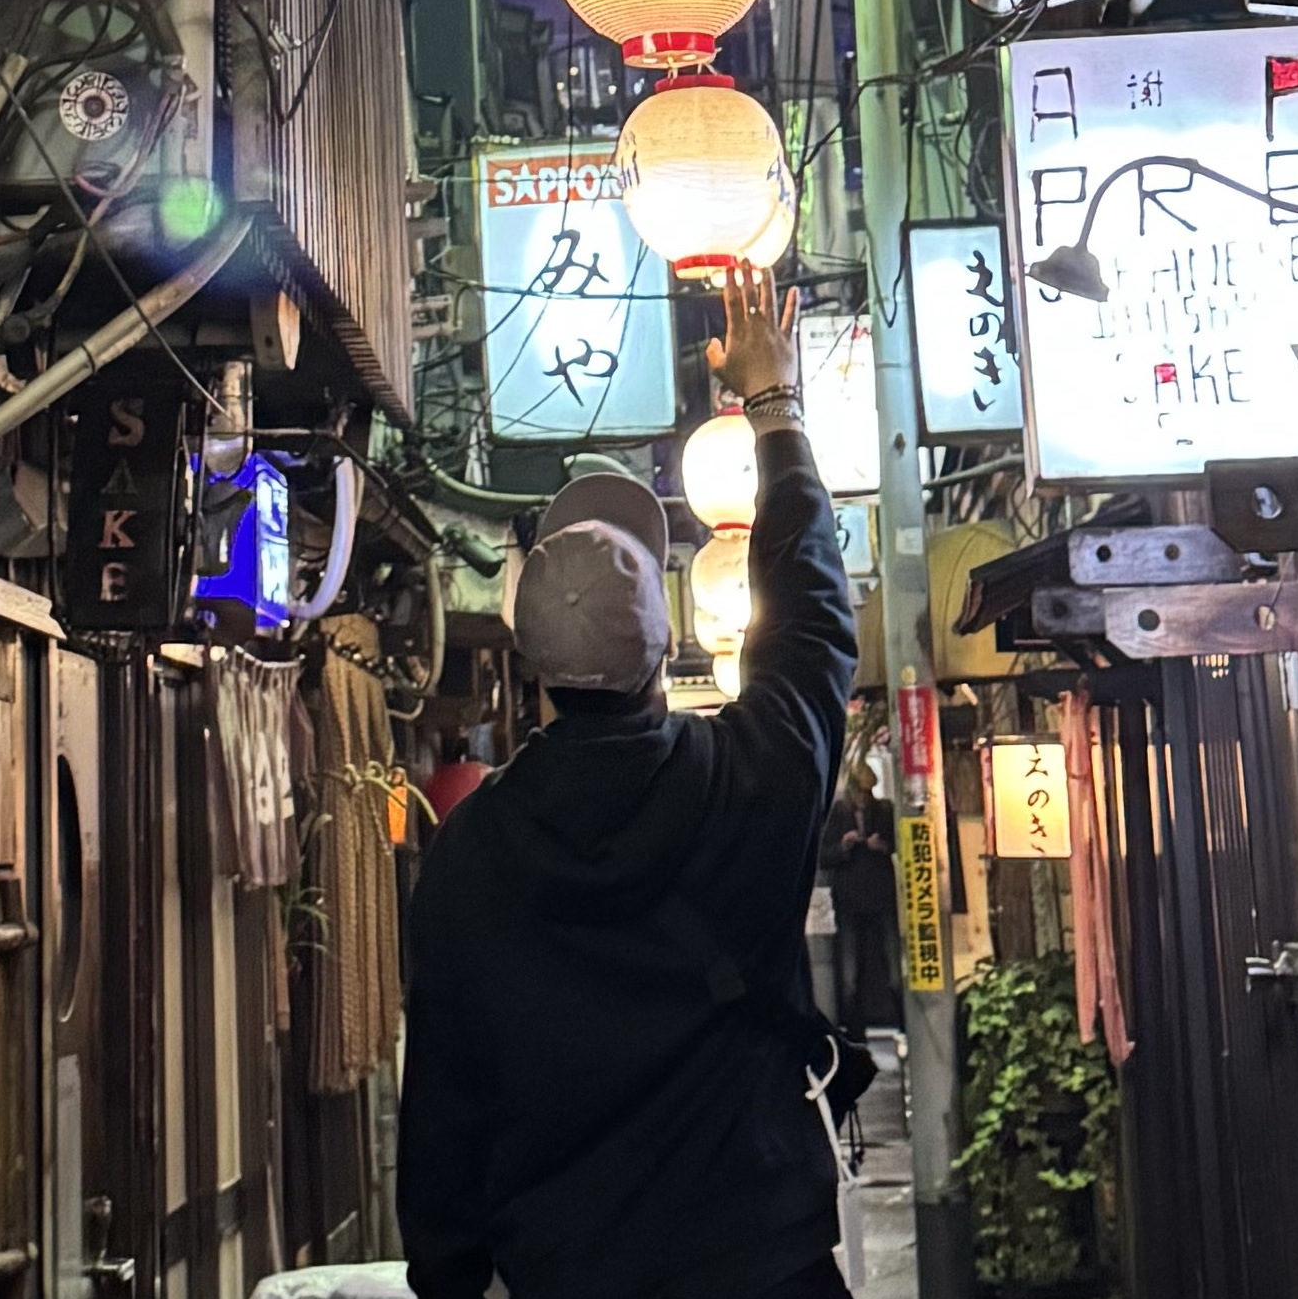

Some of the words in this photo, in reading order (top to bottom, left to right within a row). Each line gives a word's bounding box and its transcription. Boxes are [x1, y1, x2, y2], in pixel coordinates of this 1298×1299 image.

[530, 228, 619, 408] みや
[1116, 345, 1251, 405] AKE
[100, 398, 146, 602] SAKE
[1024, 744, 1050, 854] えのき
[911, 822, 940, 984] 防犯カメラ監視中
